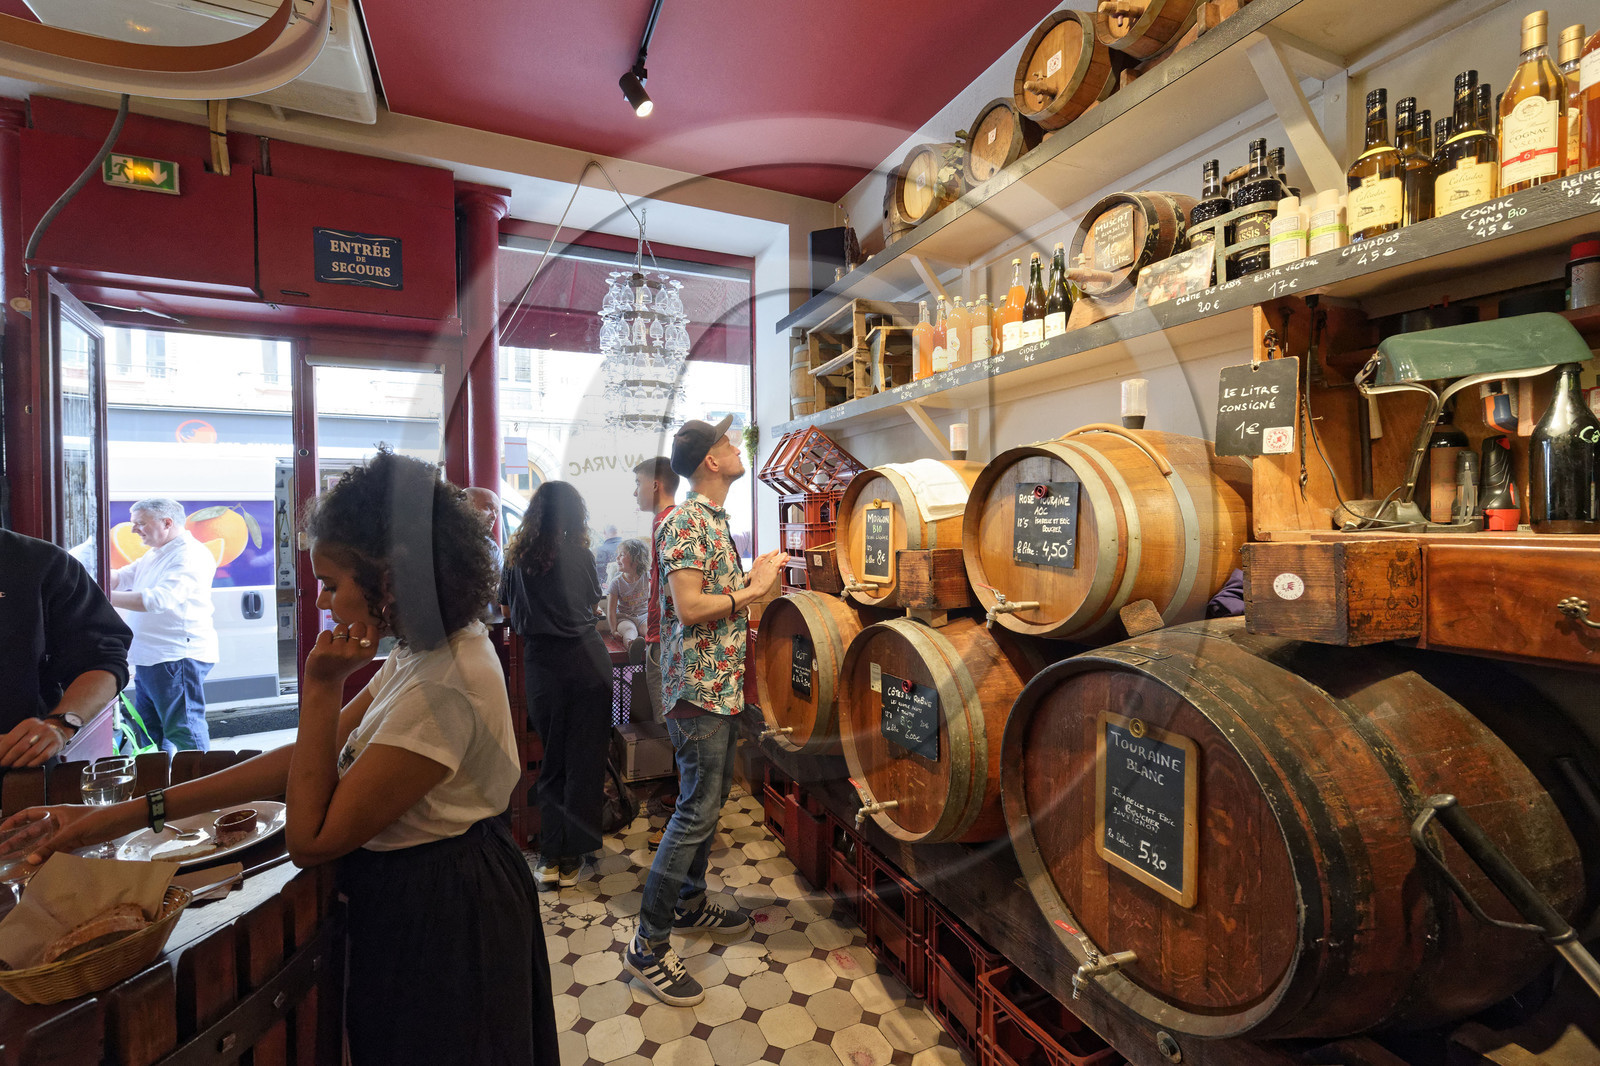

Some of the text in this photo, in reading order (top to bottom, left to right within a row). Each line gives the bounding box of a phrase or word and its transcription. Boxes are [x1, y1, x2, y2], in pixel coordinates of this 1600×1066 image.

[1509, 127, 1550, 143] COGNAC
[1567, 187, 1581, 198] DE
[1460, 197, 1514, 220] COGNAC
[1095, 211, 1131, 235] MUSCAT
[1477, 213, 1503, 227] ANS
[330, 240, 391, 259] ENTRÉE
[1341, 232, 1400, 257] CALVADOS
[356, 255, 367, 263] DE
[1357, 246, 1398, 266] 45€
[331, 261, 391, 278] SECOURS
[1176, 292, 1201, 306] CRÈME
[1205, 287, 1216, 296] DE
[1268, 278, 1299, 298] 17€
[1019, 345, 1040, 356] CIDRE
[1223, 384, 1280, 399] LE LITRE
[1219, 396, 1277, 413] CONSIGNÉ
[1235, 421, 1260, 439] 1€
[867, 513, 890, 524] MORGON
[1033, 506, 1049, 516] AOC
[872, 524, 883, 534] BIO
[876, 549, 886, 566] 8€
[887, 686, 904, 699] CÔTES
[1110, 730, 1182, 773] TOURAINE
[1126, 757, 1165, 787] BLANC
[1111, 785, 1176, 828] ISABELLE ET ERIC
[1124, 803, 1161, 830] BOUCHER
[1137, 839, 1168, 872] 5,20
